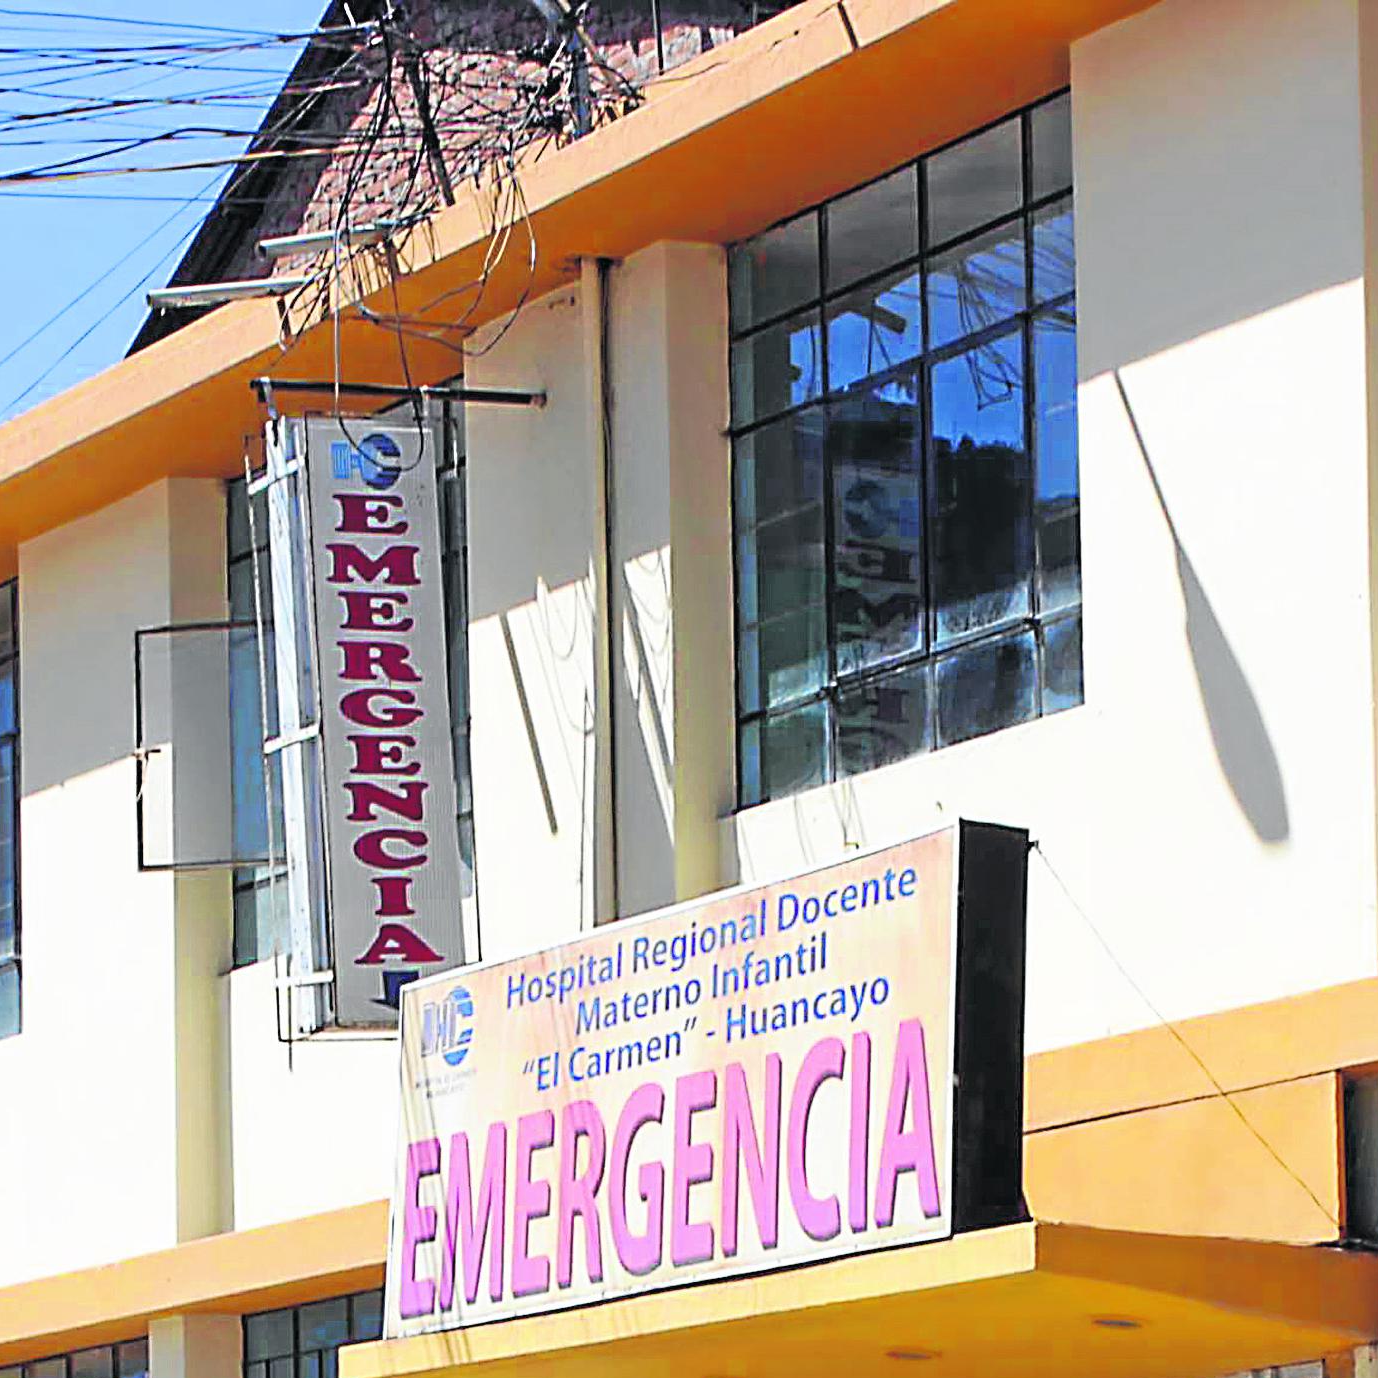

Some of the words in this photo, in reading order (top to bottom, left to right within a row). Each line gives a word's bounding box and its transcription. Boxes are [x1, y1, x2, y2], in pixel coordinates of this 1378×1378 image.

[326, 494, 444, 965] EMERGENCIA
[506, 942, 623, 1009] Hospital
[633, 898, 767, 973] Regional
[778, 866, 918, 932] Docente
[576, 976, 701, 1036] Materno
[713, 931, 827, 999] Infantil
[726, 976, 890, 1043] Huancayo
[400, 1018, 942, 1319] EMERGENCIA
